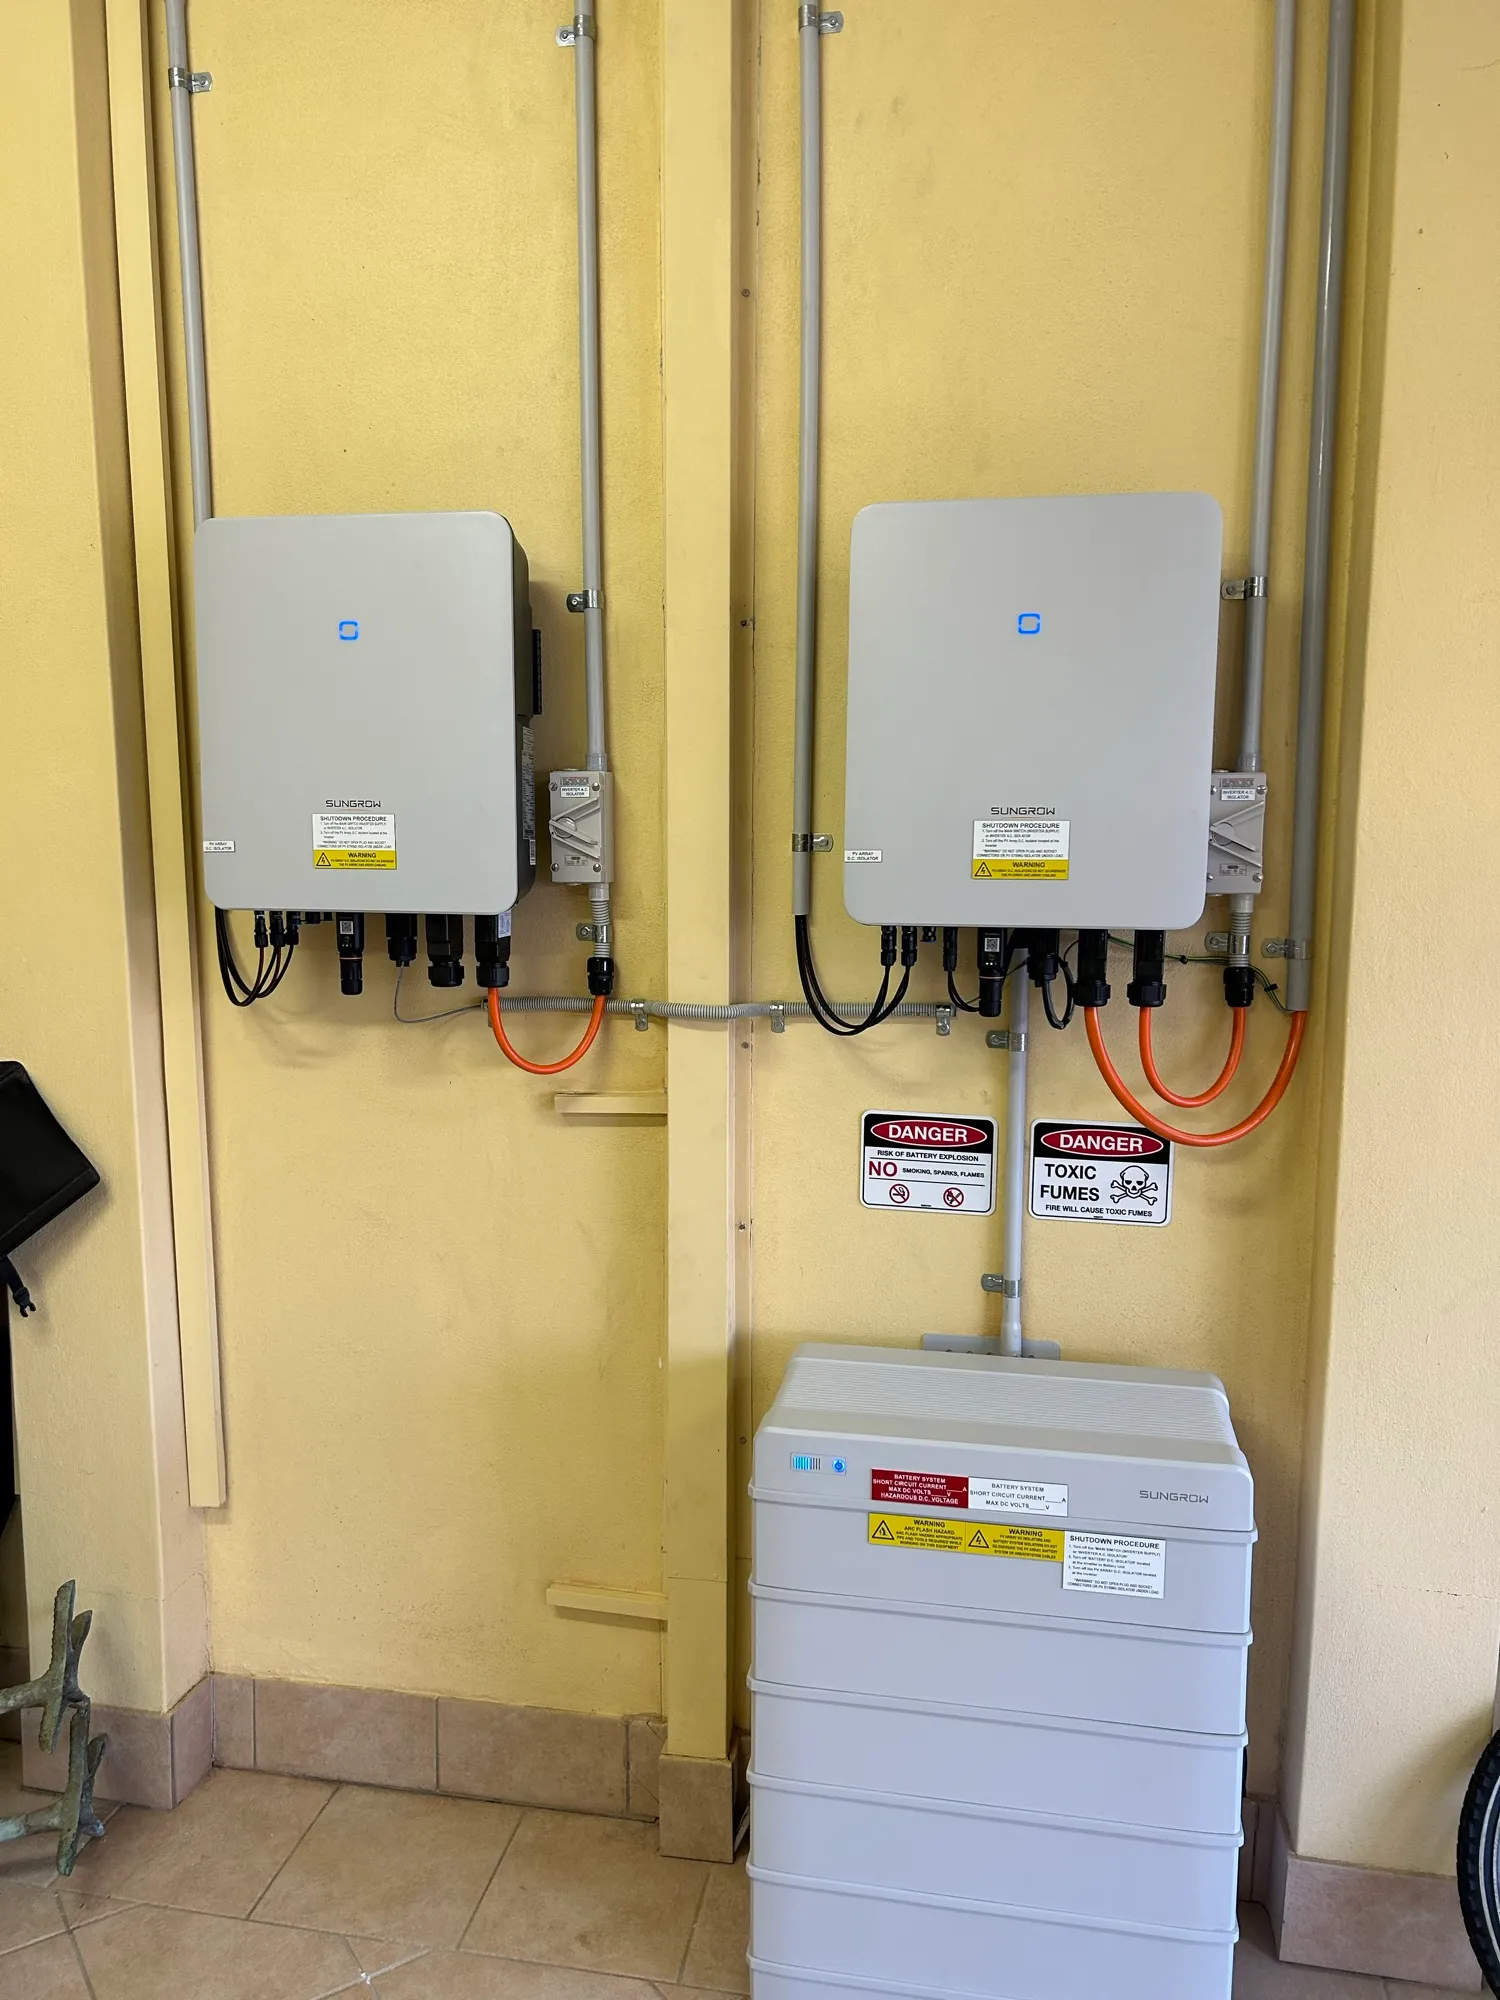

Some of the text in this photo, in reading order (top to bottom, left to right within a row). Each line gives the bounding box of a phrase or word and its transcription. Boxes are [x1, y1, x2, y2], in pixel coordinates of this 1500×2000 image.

[990, 807, 1056, 815] SUNGROW
[888, 1124, 968, 1142] DANGER
[1060, 1134, 1143, 1152] DANGER
[906, 1151, 937, 1159] BATTERY
[868, 1161, 898, 1177] NO
[902, 1167, 932, 1175] SMOKING,
[1044, 1164, 1096, 1180] TOXIC
[1040, 1184, 1100, 1201] FUMES
[1139, 1490, 1209, 1504] SUNGROW
[914, 1519, 945, 1527] WARNING
[1009, 1529, 1043, 1537] WARNING
[1070, 1535, 1160, 1549] SHUTDOWN PROCEDURE
